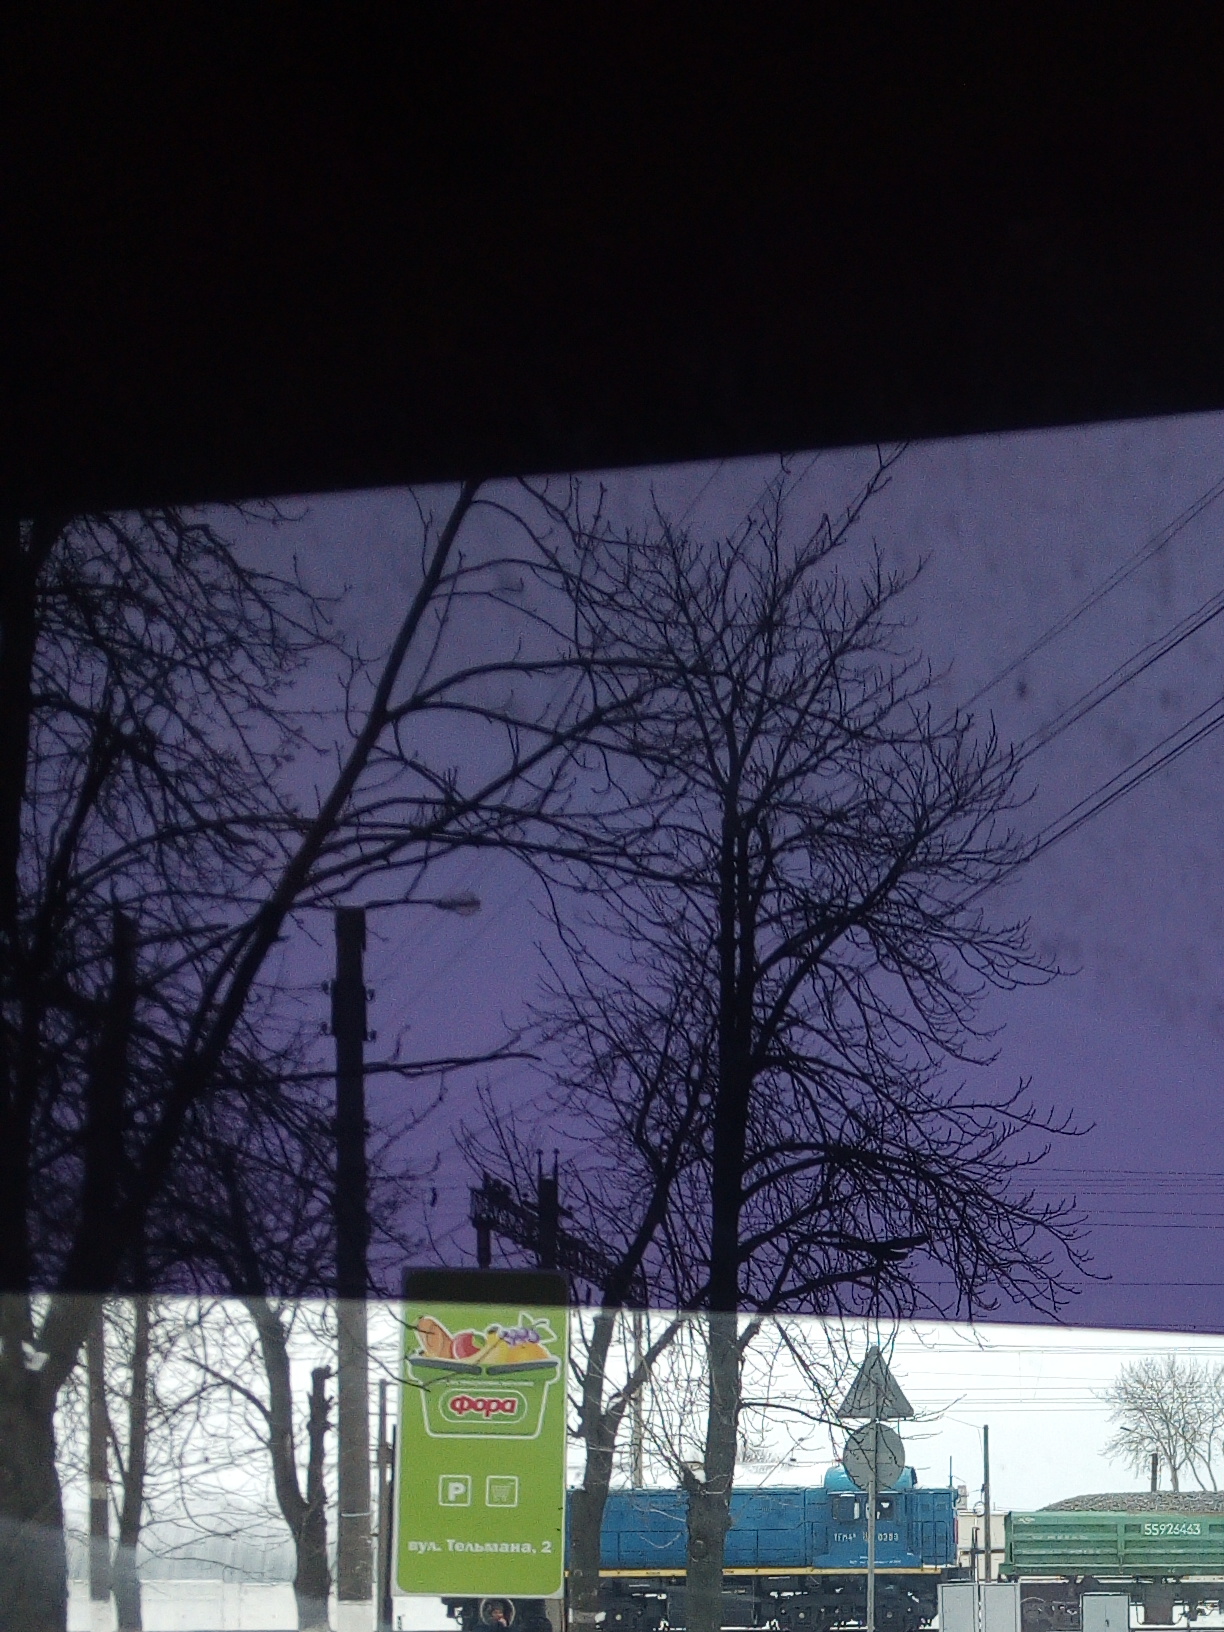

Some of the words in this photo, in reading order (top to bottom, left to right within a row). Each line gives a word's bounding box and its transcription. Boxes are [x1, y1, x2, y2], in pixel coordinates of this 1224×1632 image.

[450, 1395, 517, 1418] Фора
[1144, 1523, 1201, 1536] 55926463
[408, 1541, 442, 1554] вул.
[541, 1541, 552, 1553] 2
